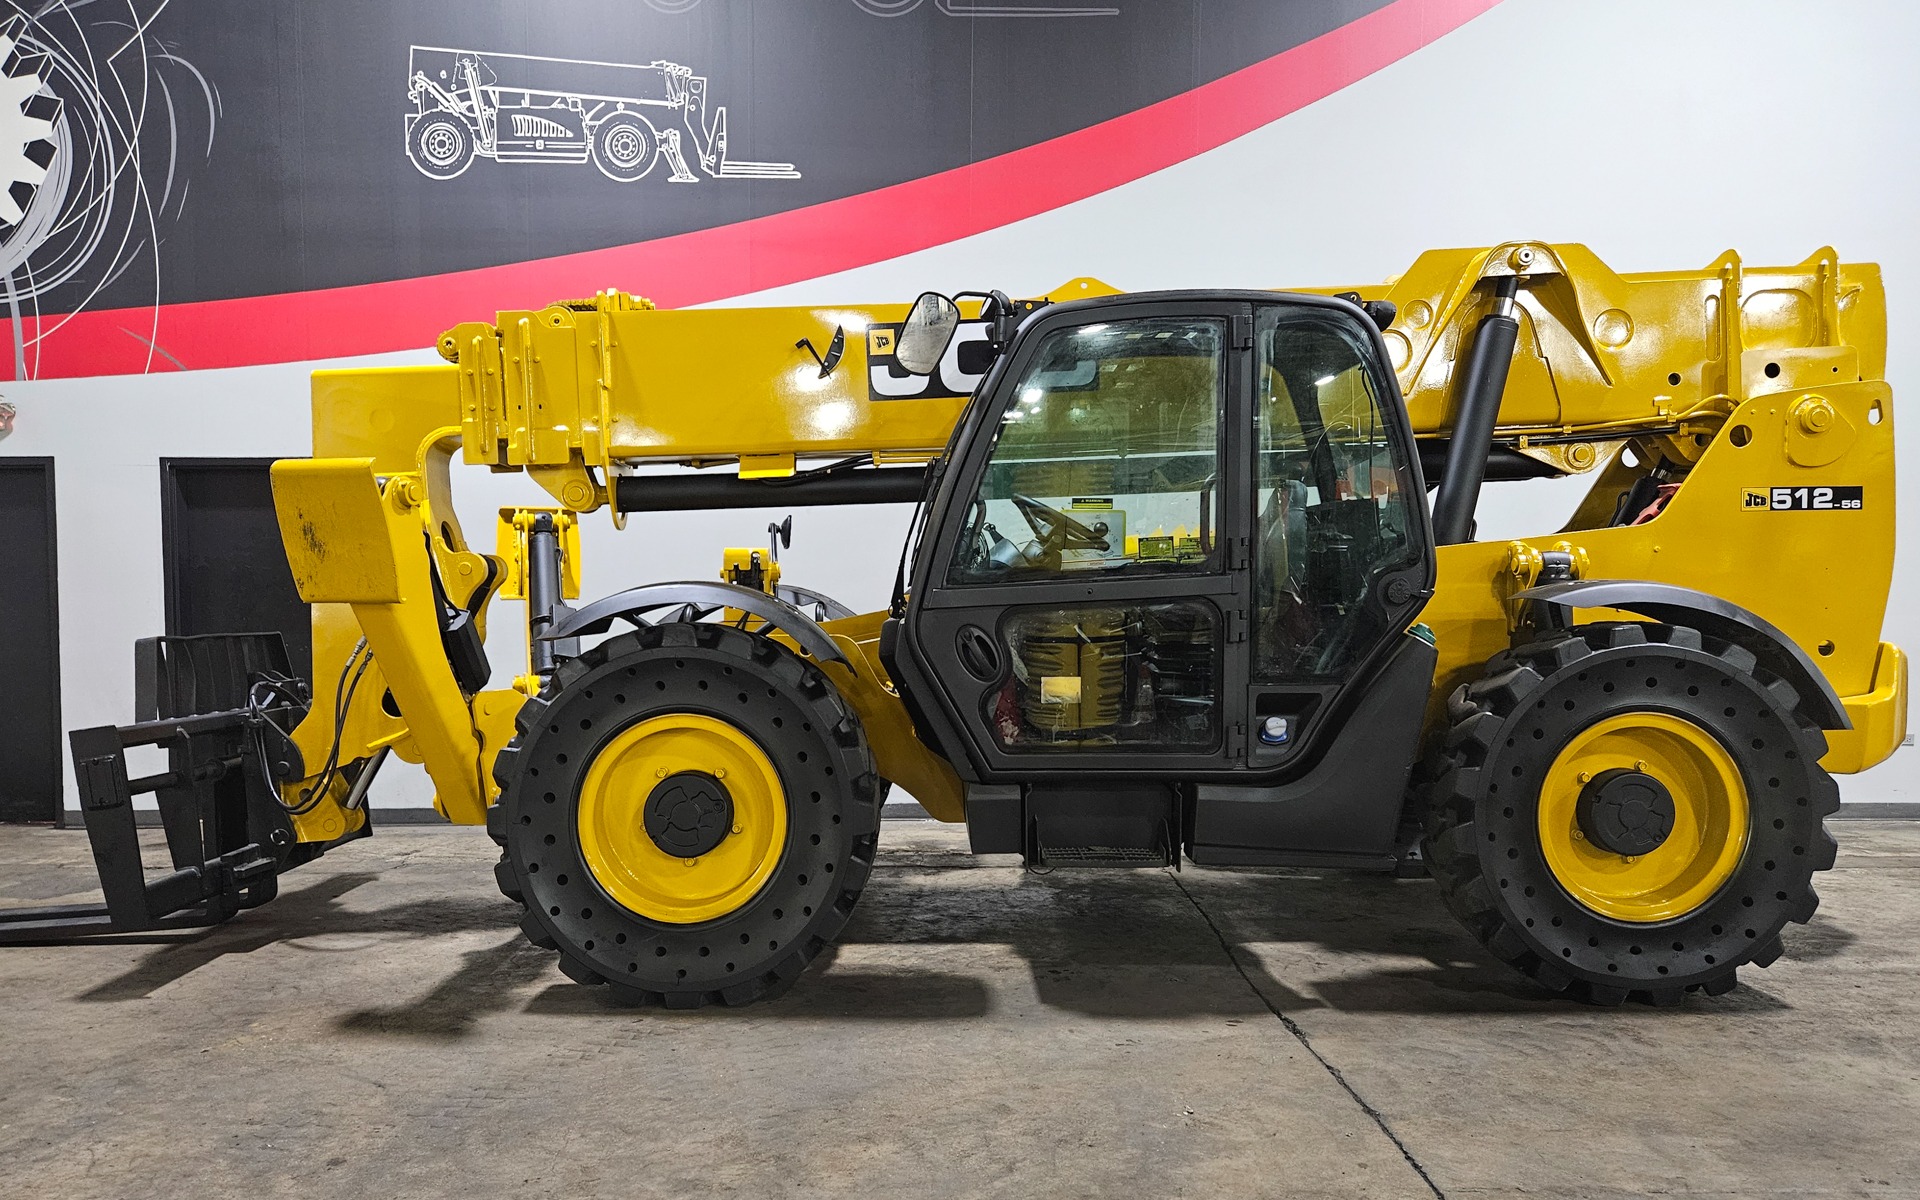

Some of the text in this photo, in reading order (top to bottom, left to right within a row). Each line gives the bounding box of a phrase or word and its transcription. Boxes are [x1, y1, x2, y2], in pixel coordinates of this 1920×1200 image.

[875, 335, 890, 349] JCB
[1745, 487, 1861, 510] JCB 512-56
